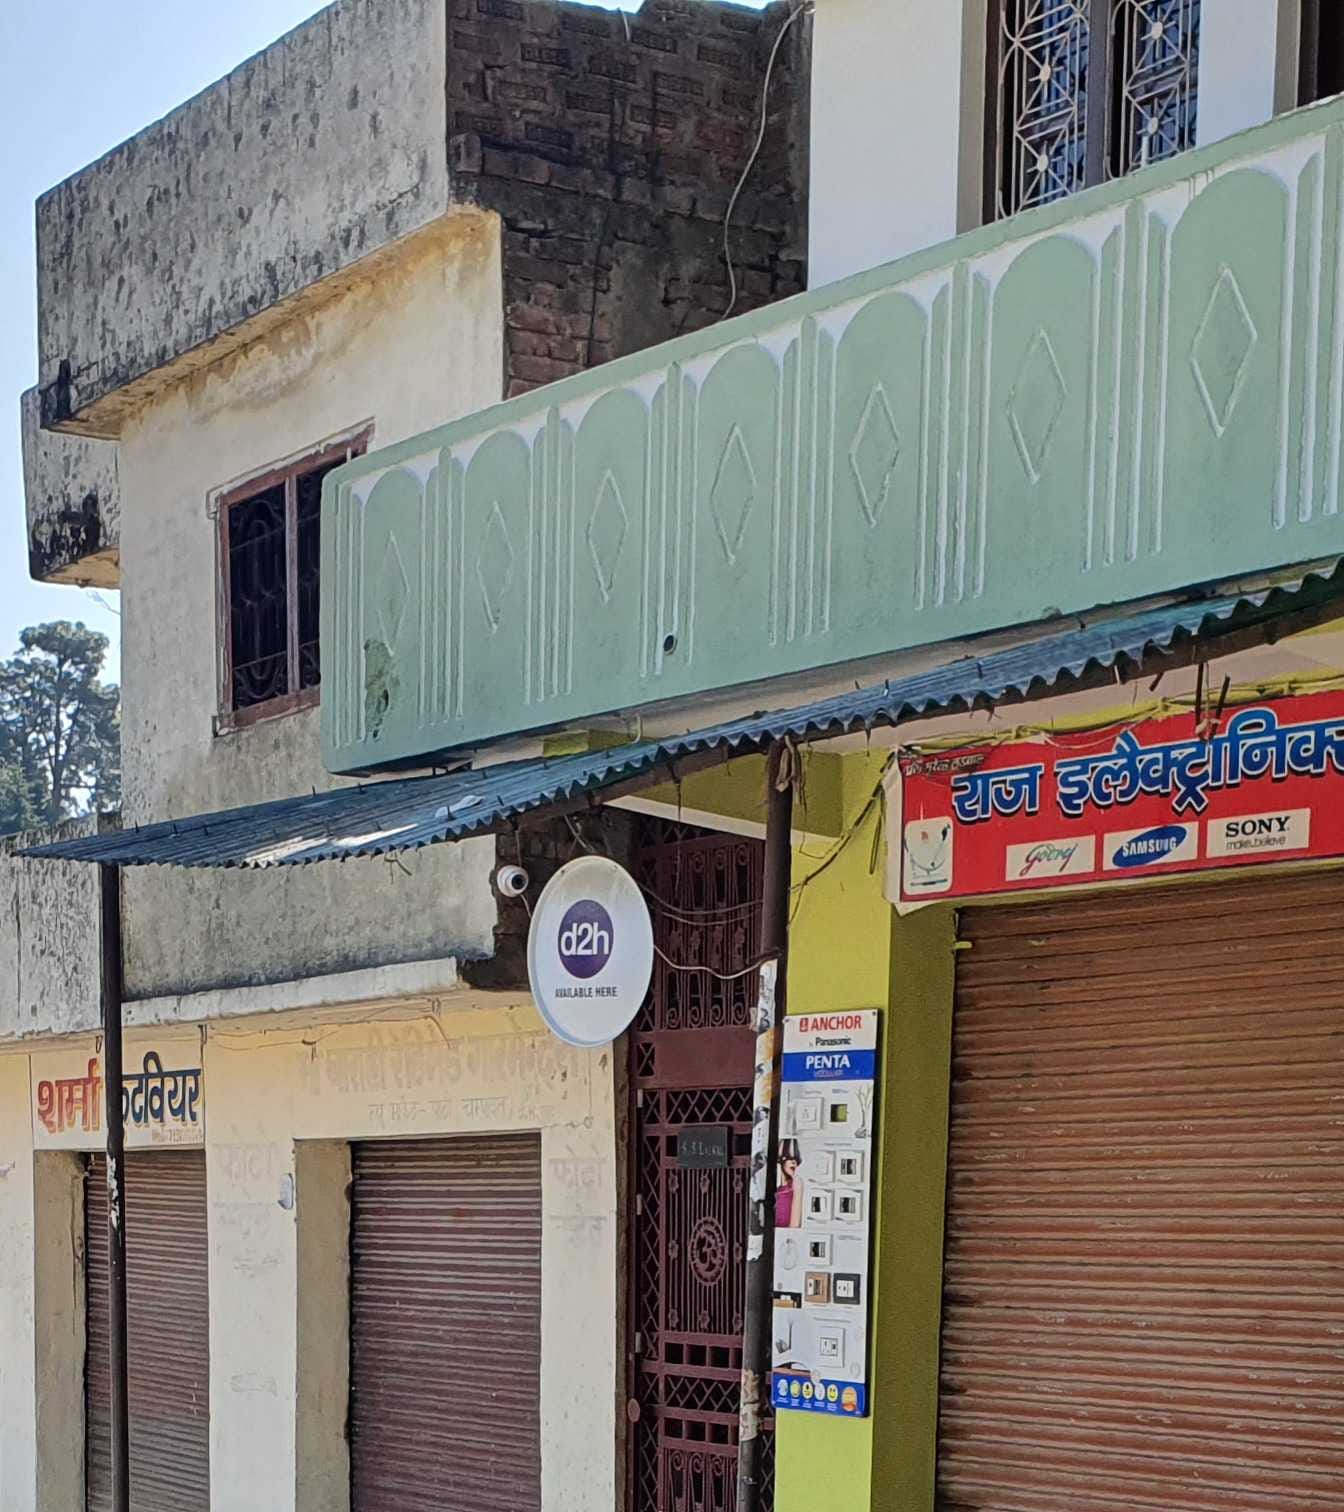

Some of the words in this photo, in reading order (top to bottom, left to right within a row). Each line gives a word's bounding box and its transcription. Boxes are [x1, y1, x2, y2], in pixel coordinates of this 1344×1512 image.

[952, 762, 1044, 822] राज
[1224, 816, 1290, 839] SONY
[1121, 836, 1178, 857] SAMSUNG
[561, 921, 609, 956] d2h
[555, 987, 593, 999] AVAILABLE
[595, 986, 618, 997] HERE
[811, 1015, 862, 1031] ANCHOR
[805, 1054, 851, 1070] PENTA
[37, 1058, 104, 1134] शर्मा
